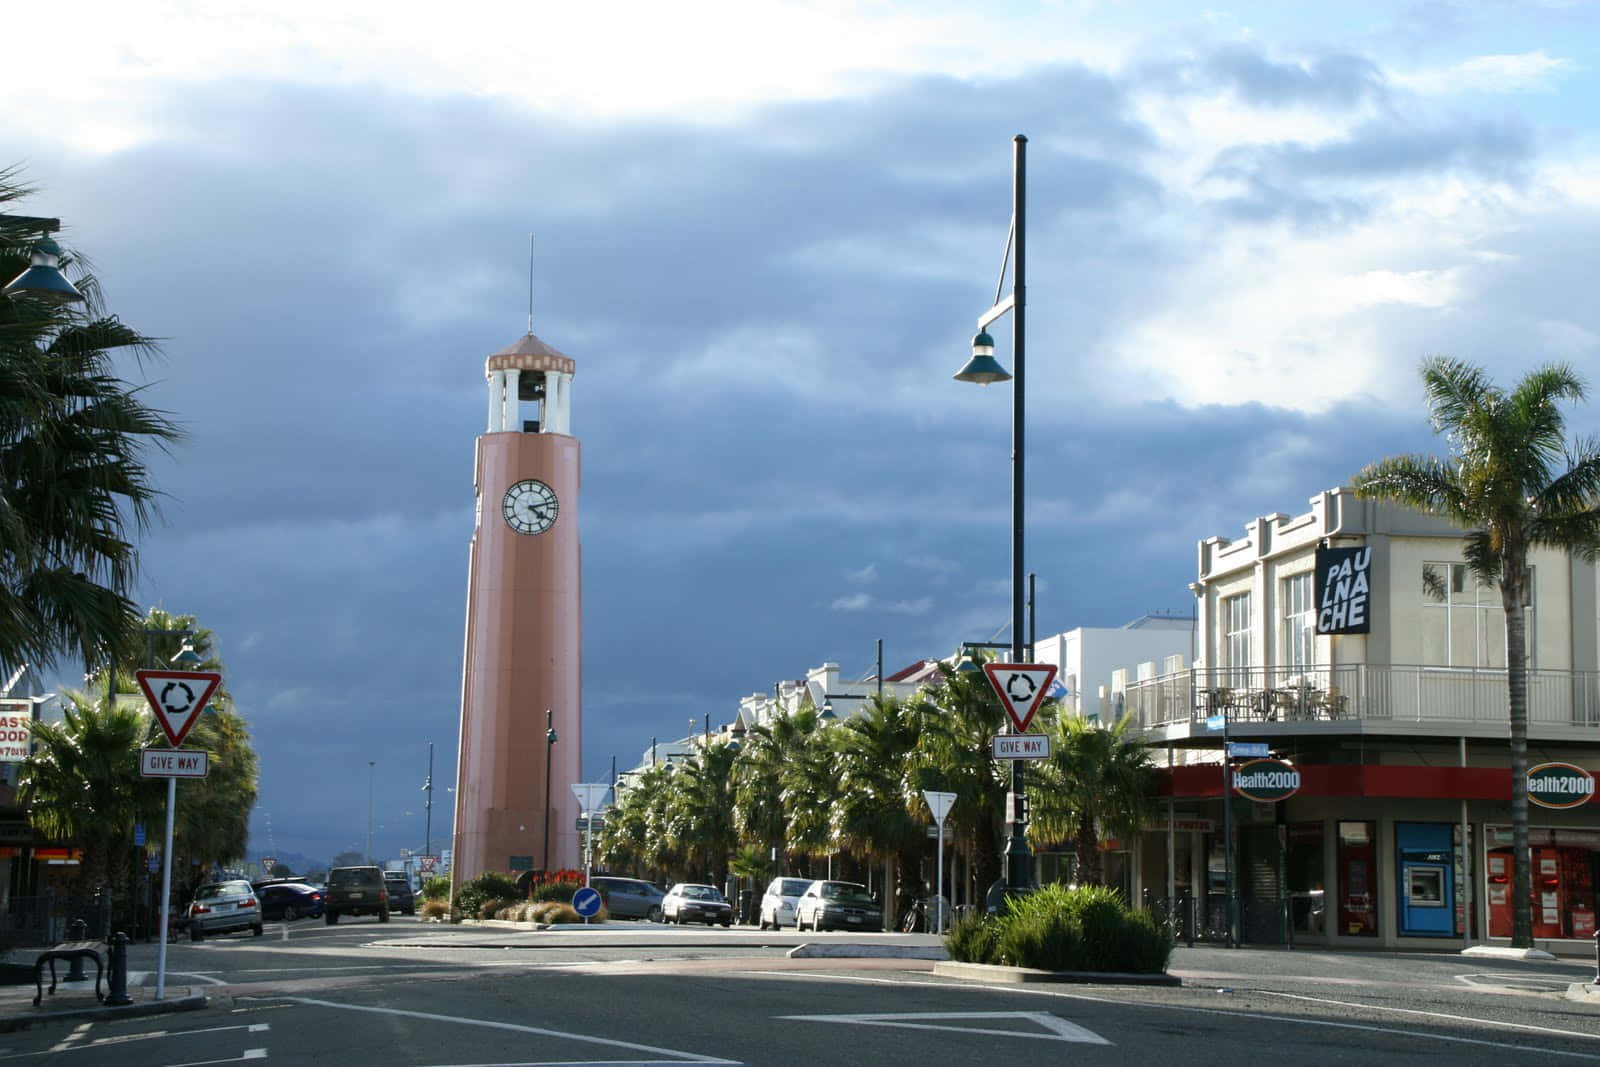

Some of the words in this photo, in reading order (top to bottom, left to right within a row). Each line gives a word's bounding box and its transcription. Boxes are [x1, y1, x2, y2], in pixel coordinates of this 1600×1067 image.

[1326, 547, 1371, 587] PAU
[1318, 595, 1367, 633] CHE
[1001, 741, 1020, 753] GIVE
[1024, 741, 1042, 753] WAY
[151, 756, 174, 769] GIVE
[178, 757, 199, 770] WAY
[1232, 771, 1299, 790] Health2000
